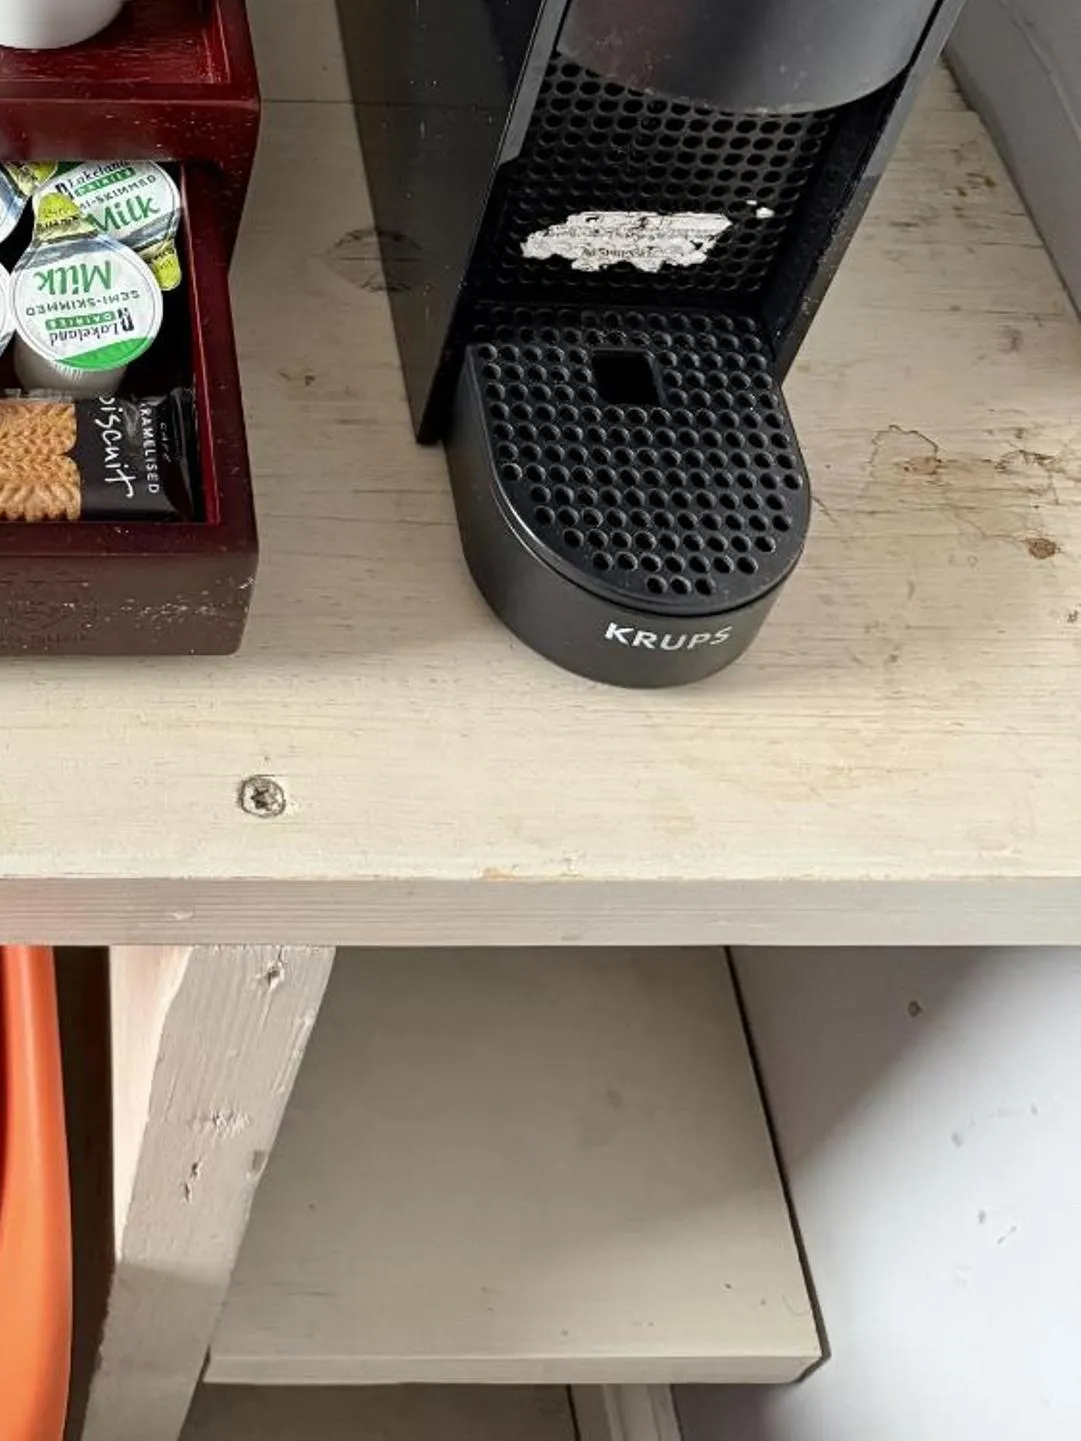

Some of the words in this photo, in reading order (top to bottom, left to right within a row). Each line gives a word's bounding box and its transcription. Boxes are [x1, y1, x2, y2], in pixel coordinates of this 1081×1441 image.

[89, 195, 161, 232] Milk
[33, 260, 113, 295] Milk
[25, 290, 140, 316] SEMI-SKIMMED
[48, 322, 118, 346] Lakeland
[603, 621, 734, 653] KRUPS
